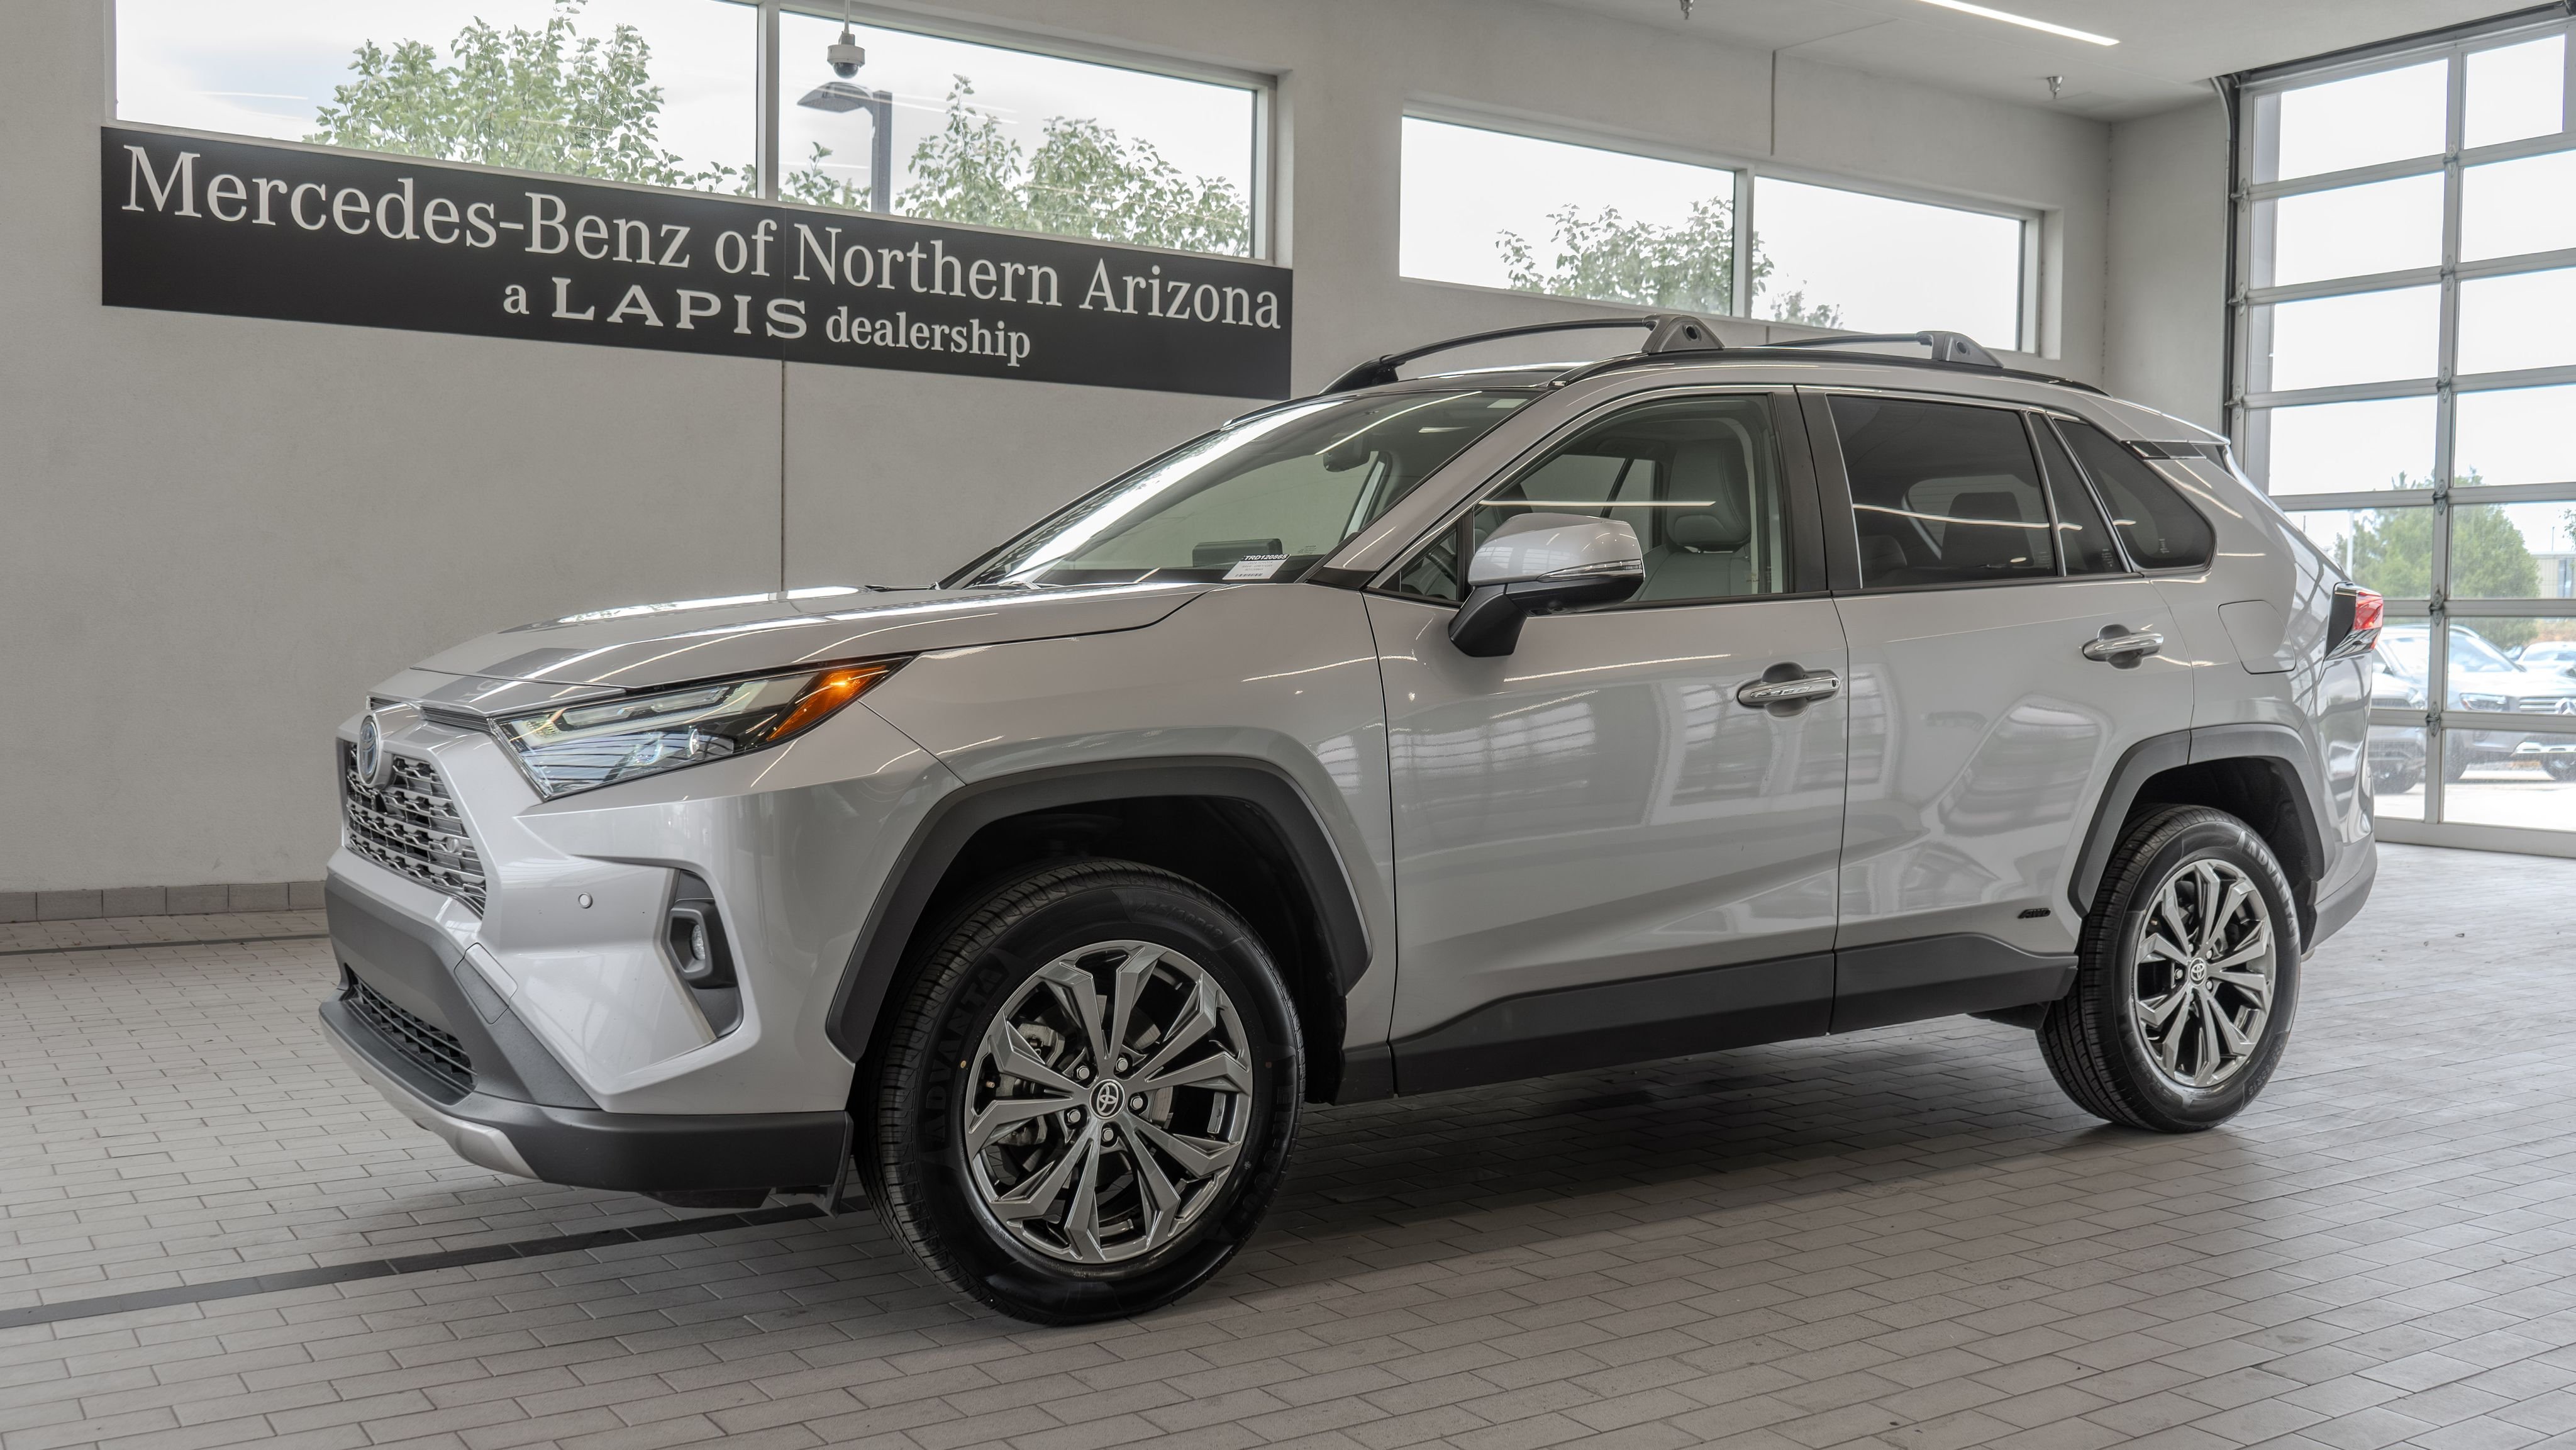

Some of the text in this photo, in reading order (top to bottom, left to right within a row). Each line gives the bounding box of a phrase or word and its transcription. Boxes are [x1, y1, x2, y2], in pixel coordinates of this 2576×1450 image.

[121, 144, 1281, 329] Mercedes-Benz of Northern Arizona
[503, 276, 1030, 367] a LAPIS dealership
[2018, 908, 2051, 919] AWD
[925, 964, 1004, 1144] ADVANTA
